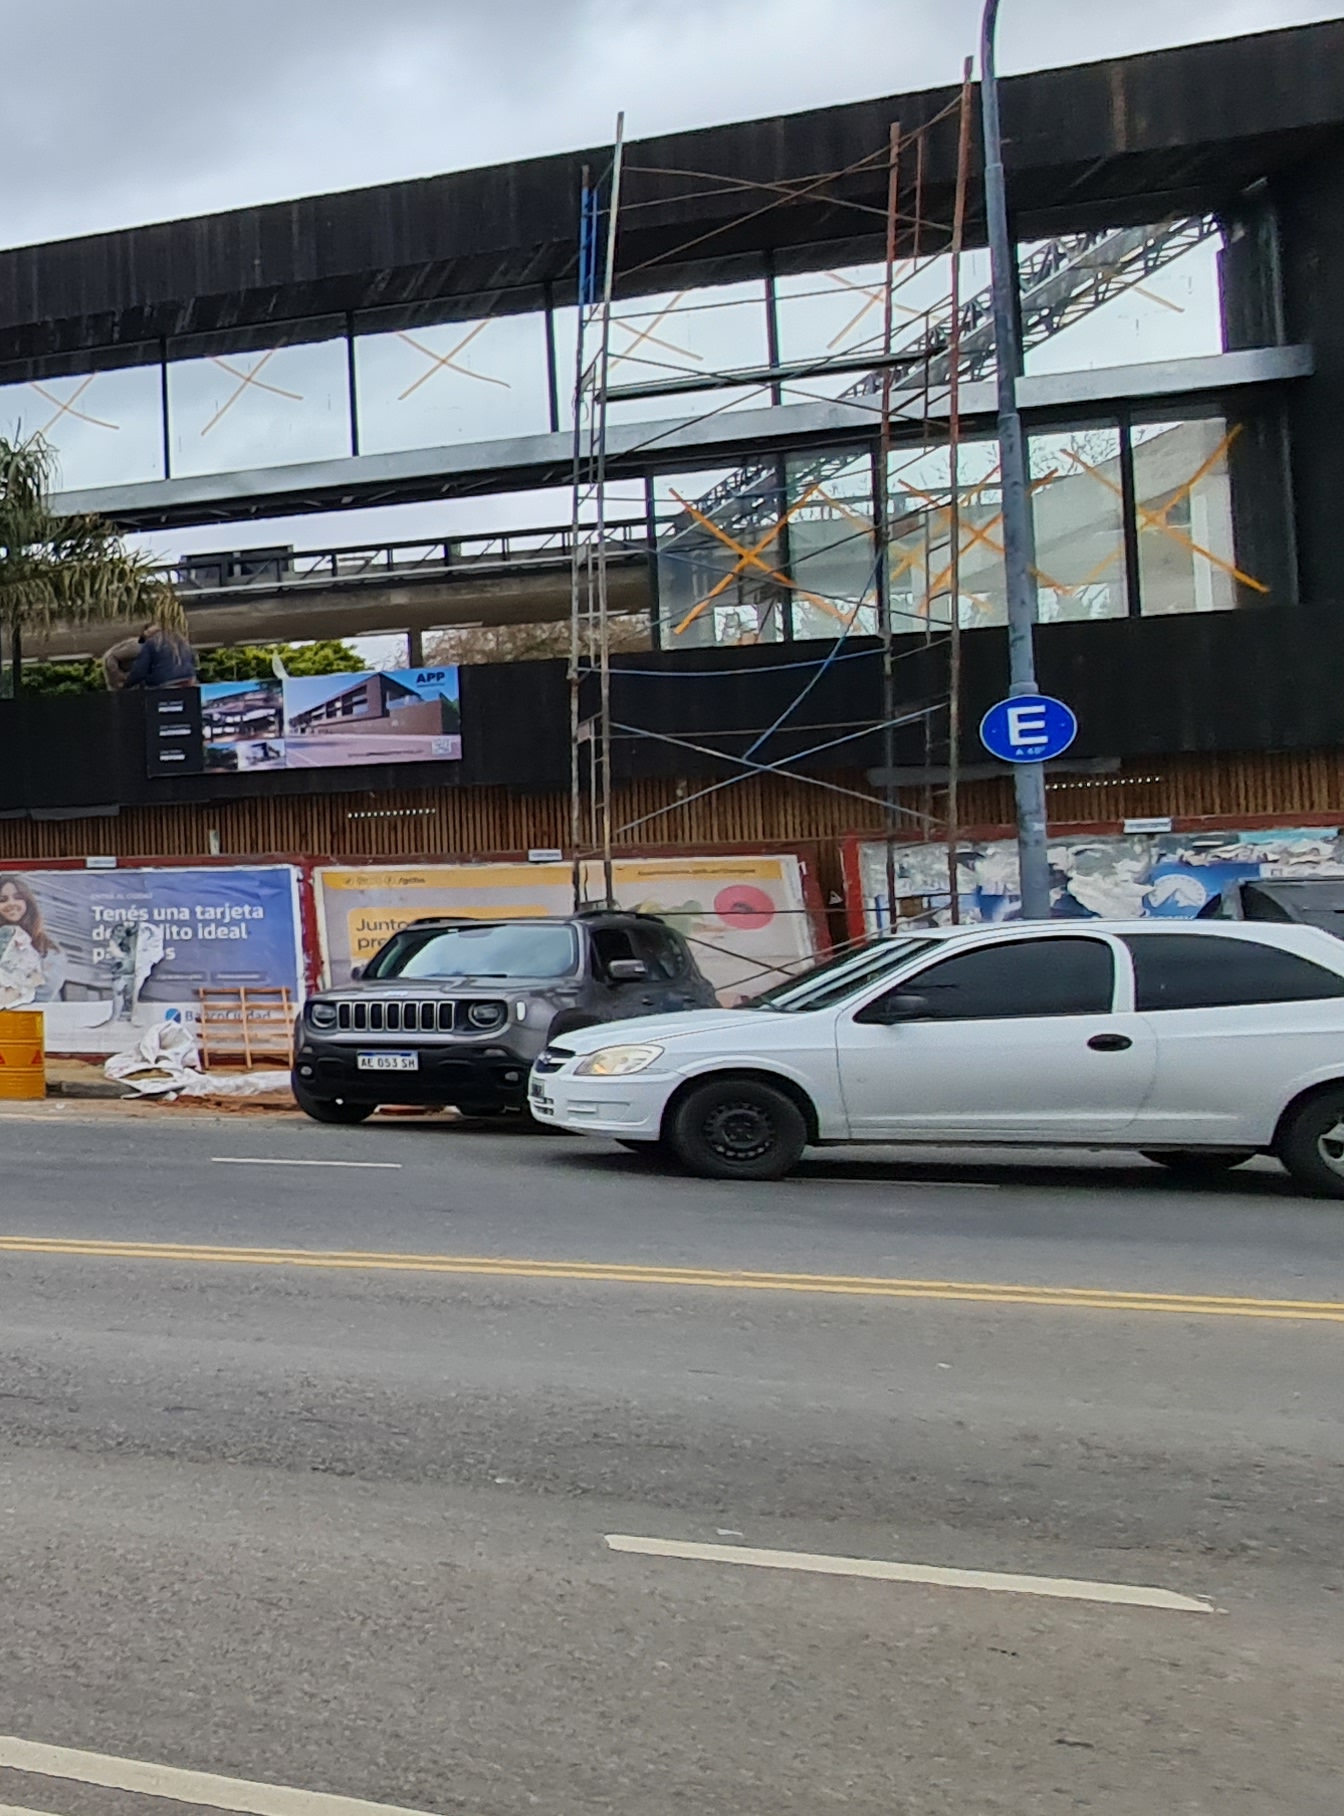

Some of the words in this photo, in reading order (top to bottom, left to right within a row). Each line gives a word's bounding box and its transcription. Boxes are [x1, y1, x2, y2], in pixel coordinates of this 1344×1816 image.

[416, 671, 445, 683] APP
[1007, 704, 1049, 746] E
[91, 904, 148, 921] Tenés
[153, 907, 190, 919] una
[196, 902, 264, 923] tarjeta
[197, 922, 248, 940] ideal
[361, 1057, 374, 1067] AE
[377, 1058, 398, 1068] 053
[401, 1058, 415, 1068] SH
